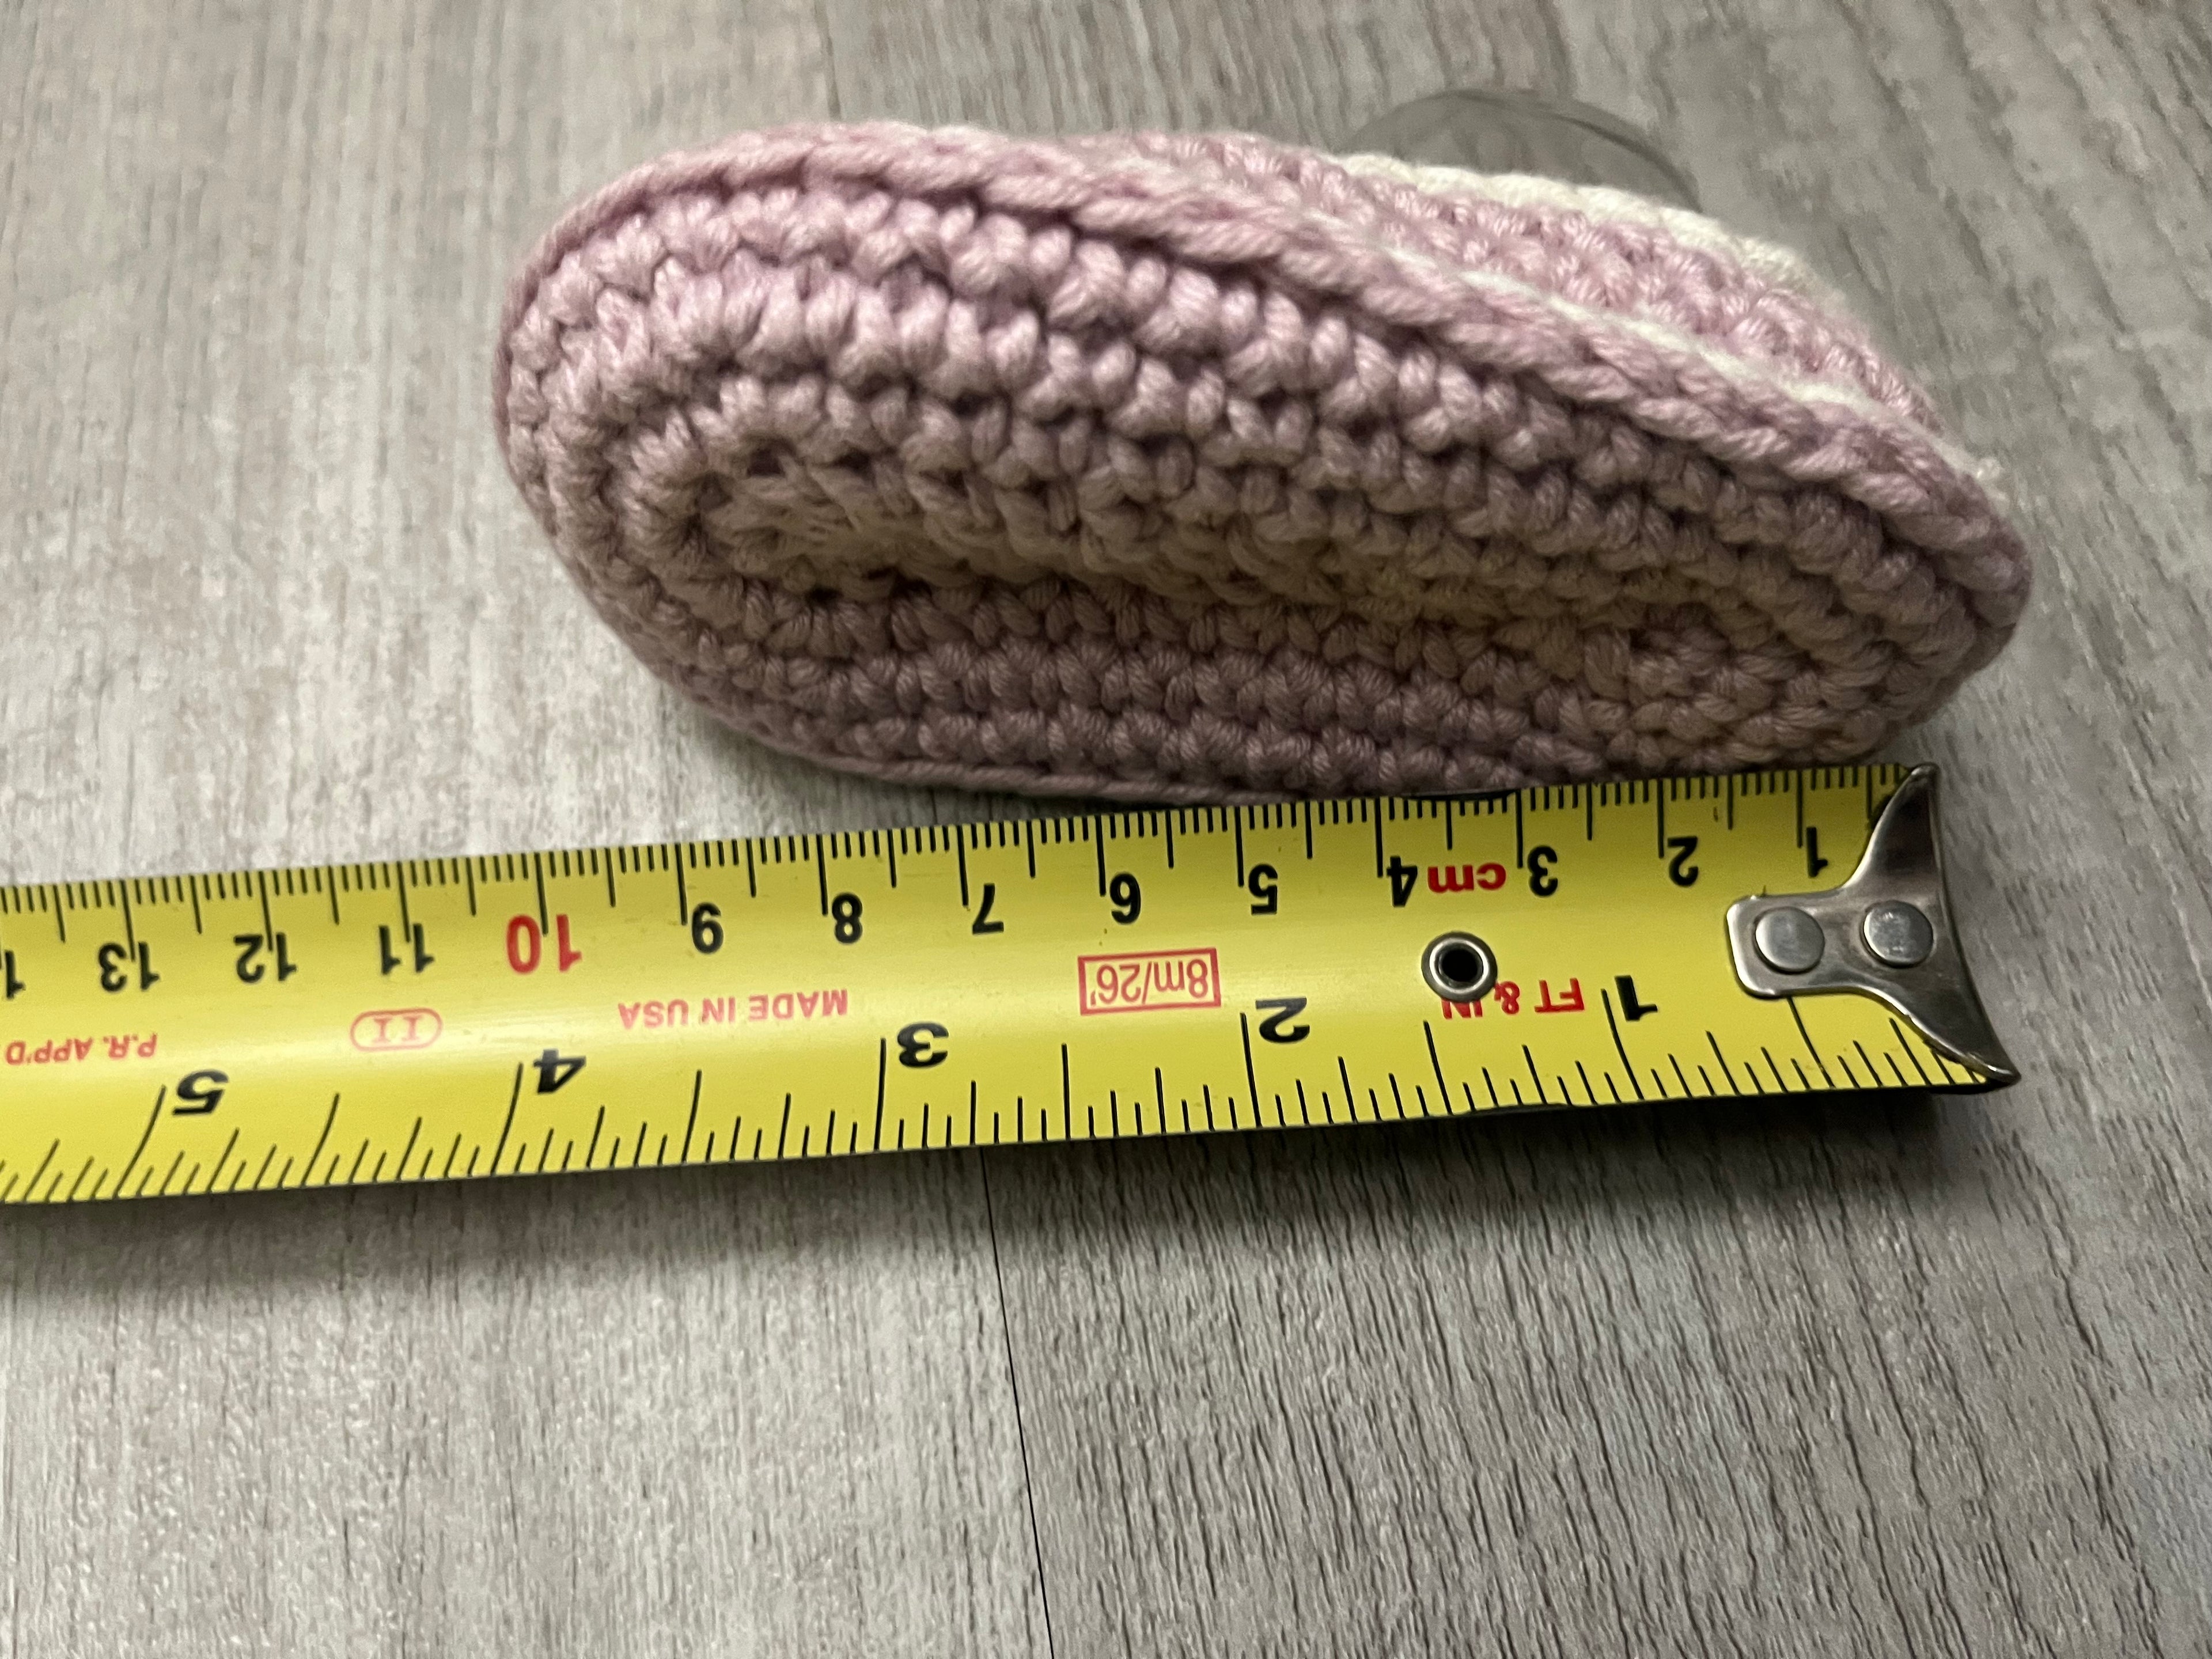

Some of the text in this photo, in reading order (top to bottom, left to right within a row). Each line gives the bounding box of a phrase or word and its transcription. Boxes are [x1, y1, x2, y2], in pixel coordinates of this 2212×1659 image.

[1427, 862, 1506, 892] cm
[1528, 846, 1558, 897] 3
[1668, 836, 1698, 887] 2
[1805, 827, 1828, 878] 1
[1109, 872, 1142, 924] 6
[1248, 864, 1279, 915] 5
[1387, 856, 1418, 908] 4
[692, 903, 724, 954] 9
[831, 893, 863, 944] 8
[971, 883, 1004, 935] 7
[99, 942, 160, 993] 13
[234, 933, 297, 983] 12
[378, 923, 434, 975] 11
[505, 914, 582, 974] 10
[618, 990, 849, 1029] MADE IN USA
[1255, 997, 1310, 1044] 2
[1493, 981, 1520, 1016] &
[1534, 978, 1585, 1014] FT
[1615, 976, 1658, 1021] 1
[5, 1033, 157, 1065] P.R. APP'D
[897, 1022, 949, 1069] 3
[172, 1069, 229, 1116] 5
[533, 1049, 586, 1094] 4
